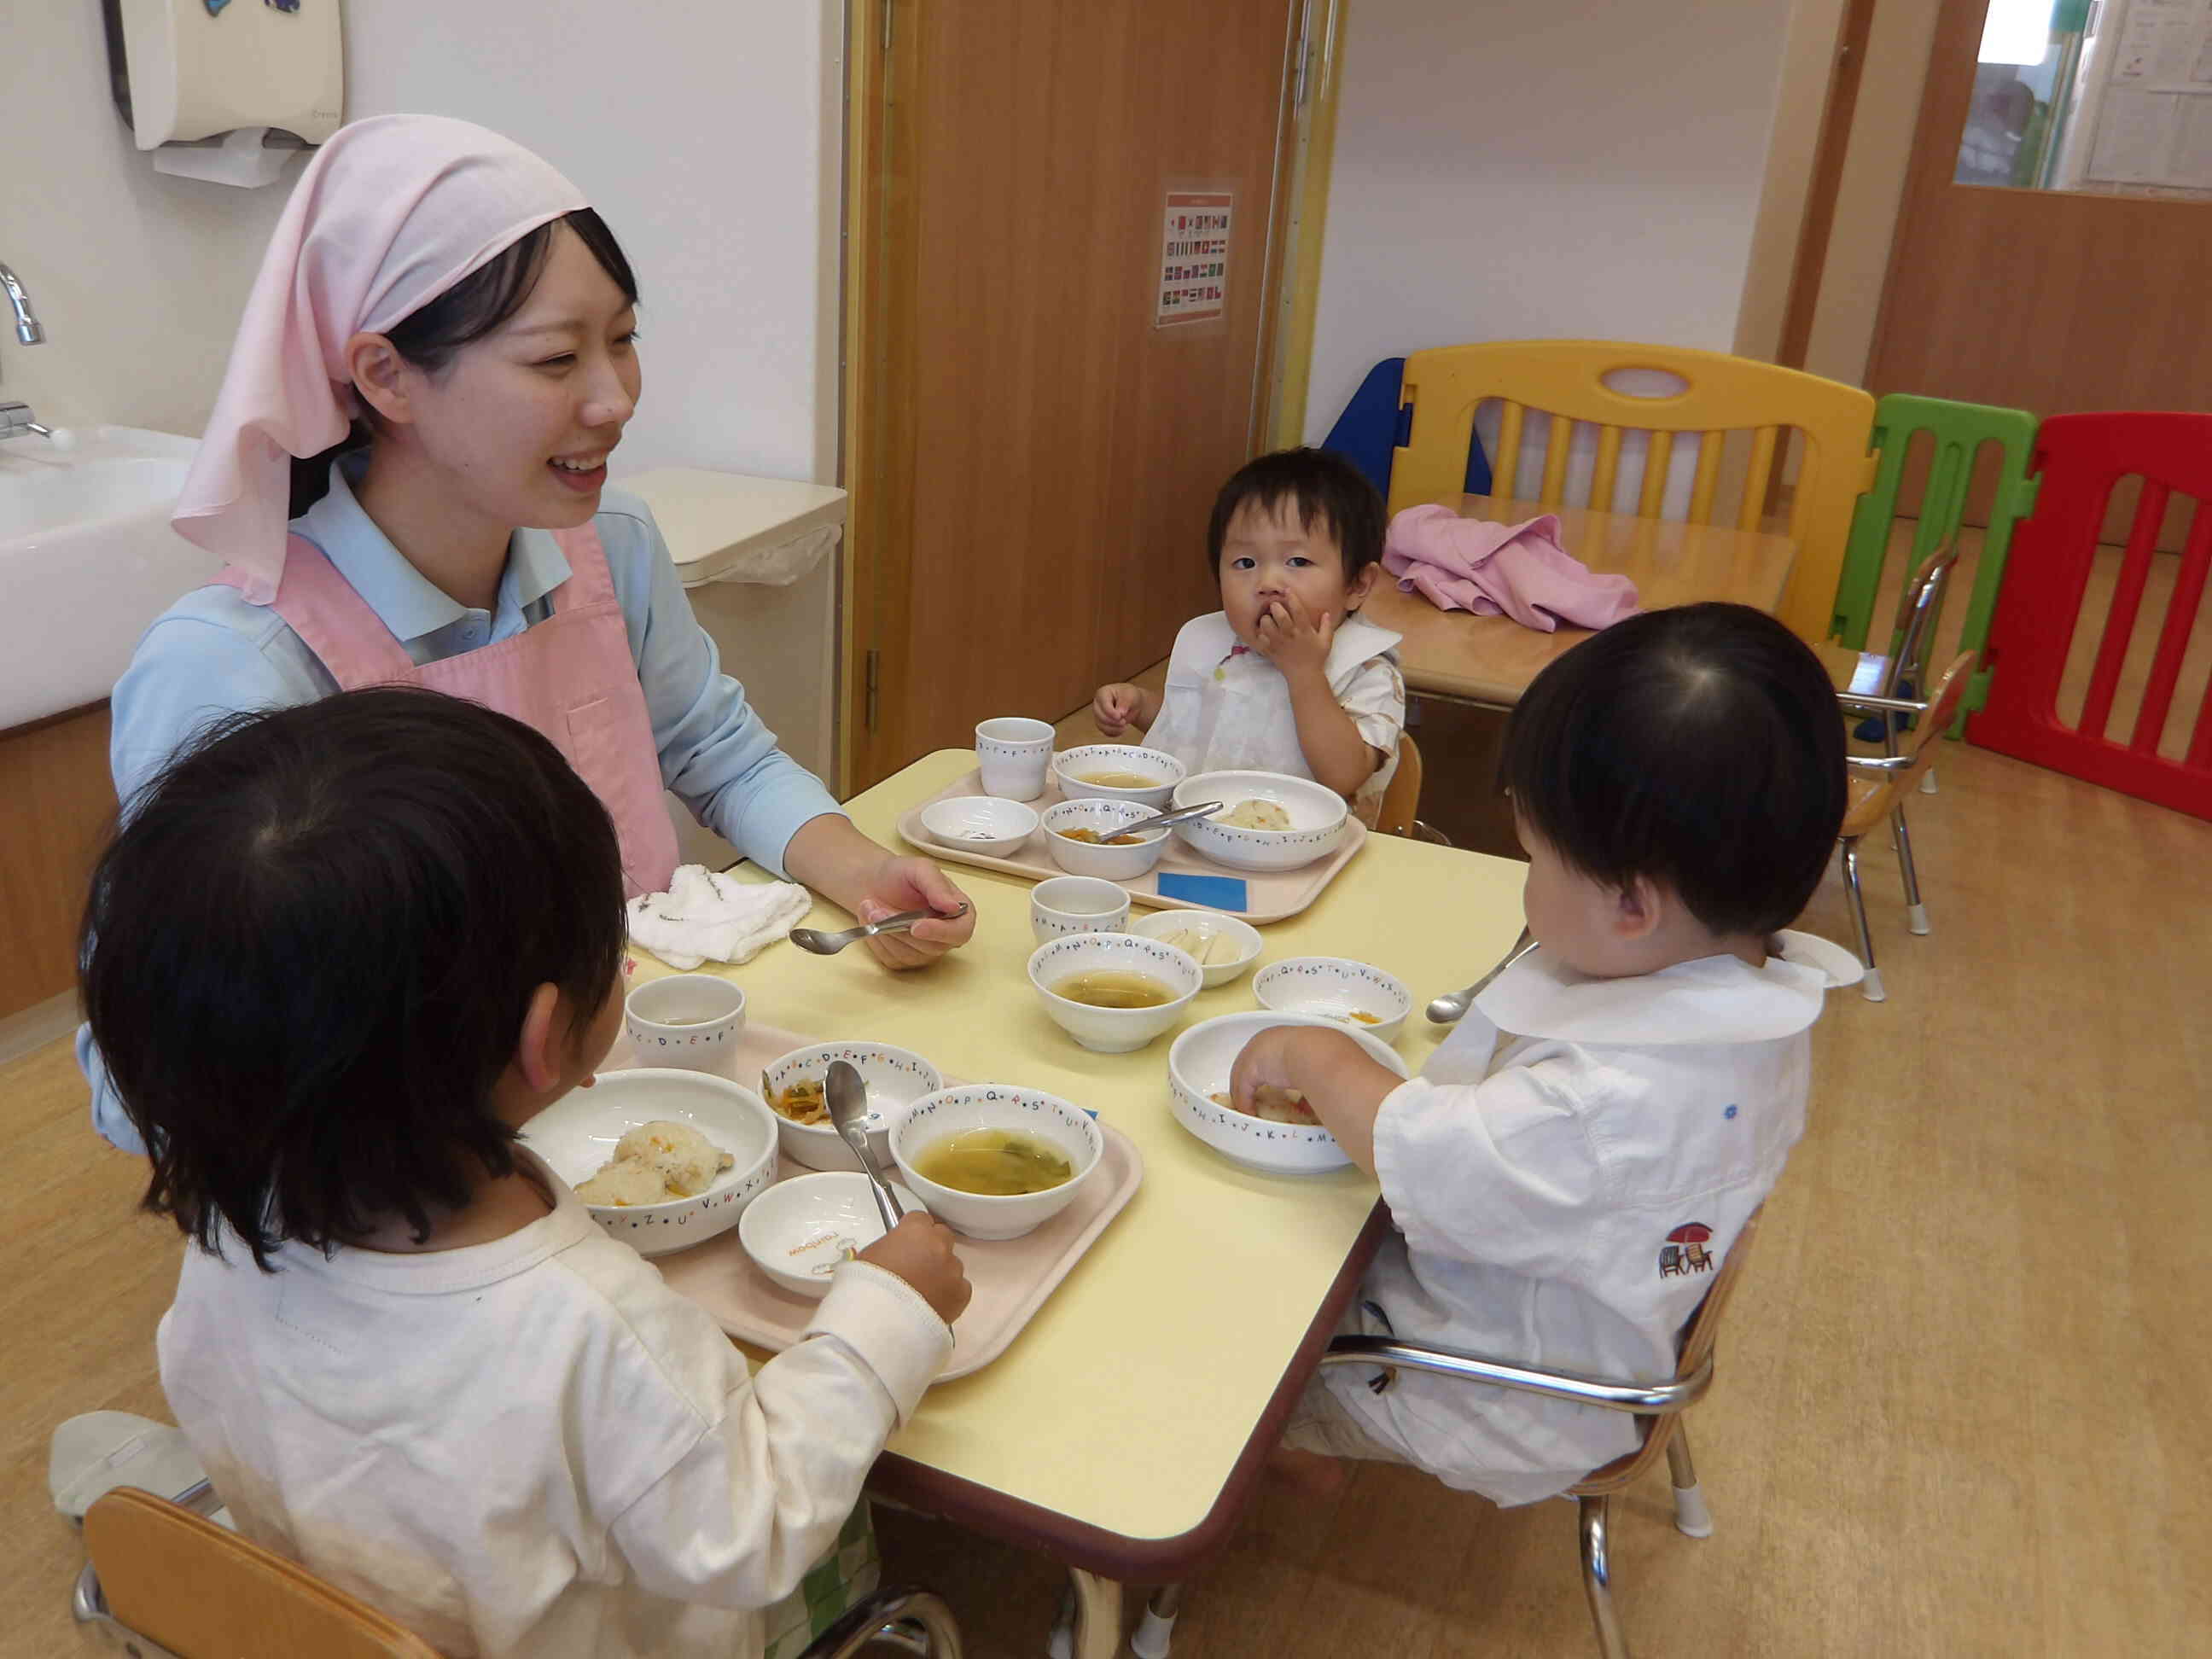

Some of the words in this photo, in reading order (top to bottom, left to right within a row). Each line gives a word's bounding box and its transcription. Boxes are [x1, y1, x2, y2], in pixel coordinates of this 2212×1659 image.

[1125, 938, 1133, 947] Q
[1281, 966, 1289, 975] Q
[658, 1037, 667, 1045] D
[690, 1035, 698, 1045] E
[822, 1053, 830, 1062] D
[843, 1050, 852, 1059] E
[861, 1055, 867, 1066] F
[928, 1102, 936, 1114] N
[945, 1094, 954, 1104] O
[964, 1096, 971, 1105] P
[986, 1091, 998, 1101] Q
[1011, 1094, 1021, 1104] R
[1032, 1101, 1039, 1111] S
[1267, 1130, 1275, 1139] K
[644, 1214, 655, 1225] Z
[678, 1215, 687, 1225] U
[702, 1198, 710, 1209] V
